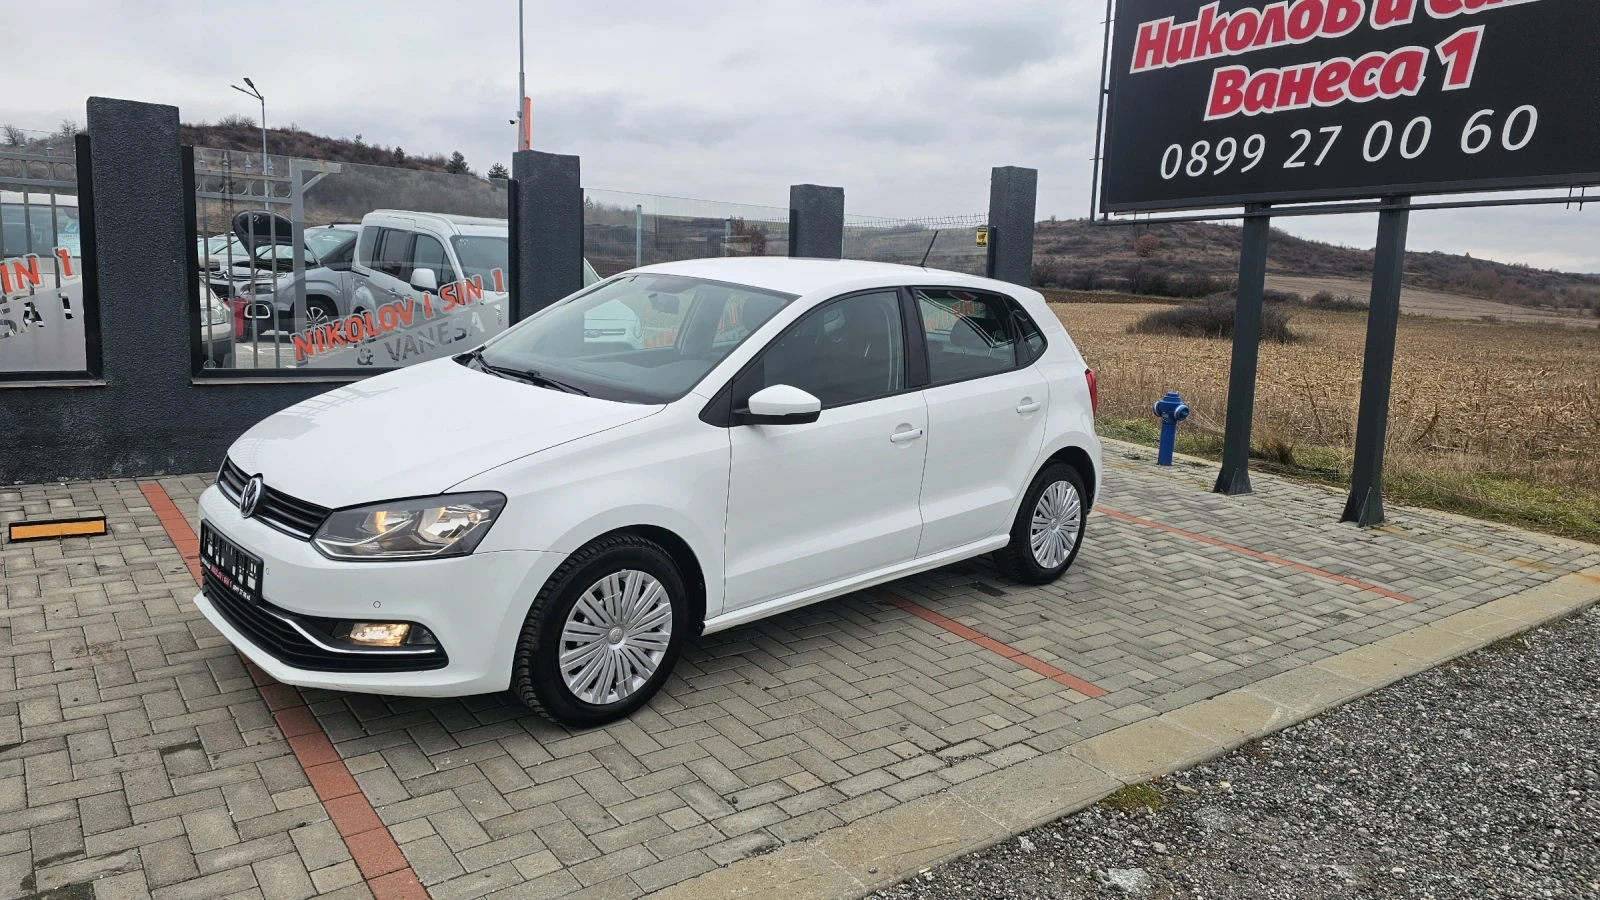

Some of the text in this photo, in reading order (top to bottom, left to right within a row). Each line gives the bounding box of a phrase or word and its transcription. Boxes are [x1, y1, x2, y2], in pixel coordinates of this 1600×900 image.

[1129, 0, 1365, 74] Николов
[1203, 24, 1486, 121] Ванеса 1
[1160, 104, 1538, 180] 0899 27 00 60
[0, 253, 45, 295] IN
[289, 295, 415, 363] NIKOLOV
[422, 290, 436, 320] I
[438, 274, 485, 315] SIN
[384, 311, 486, 363] VANESA
